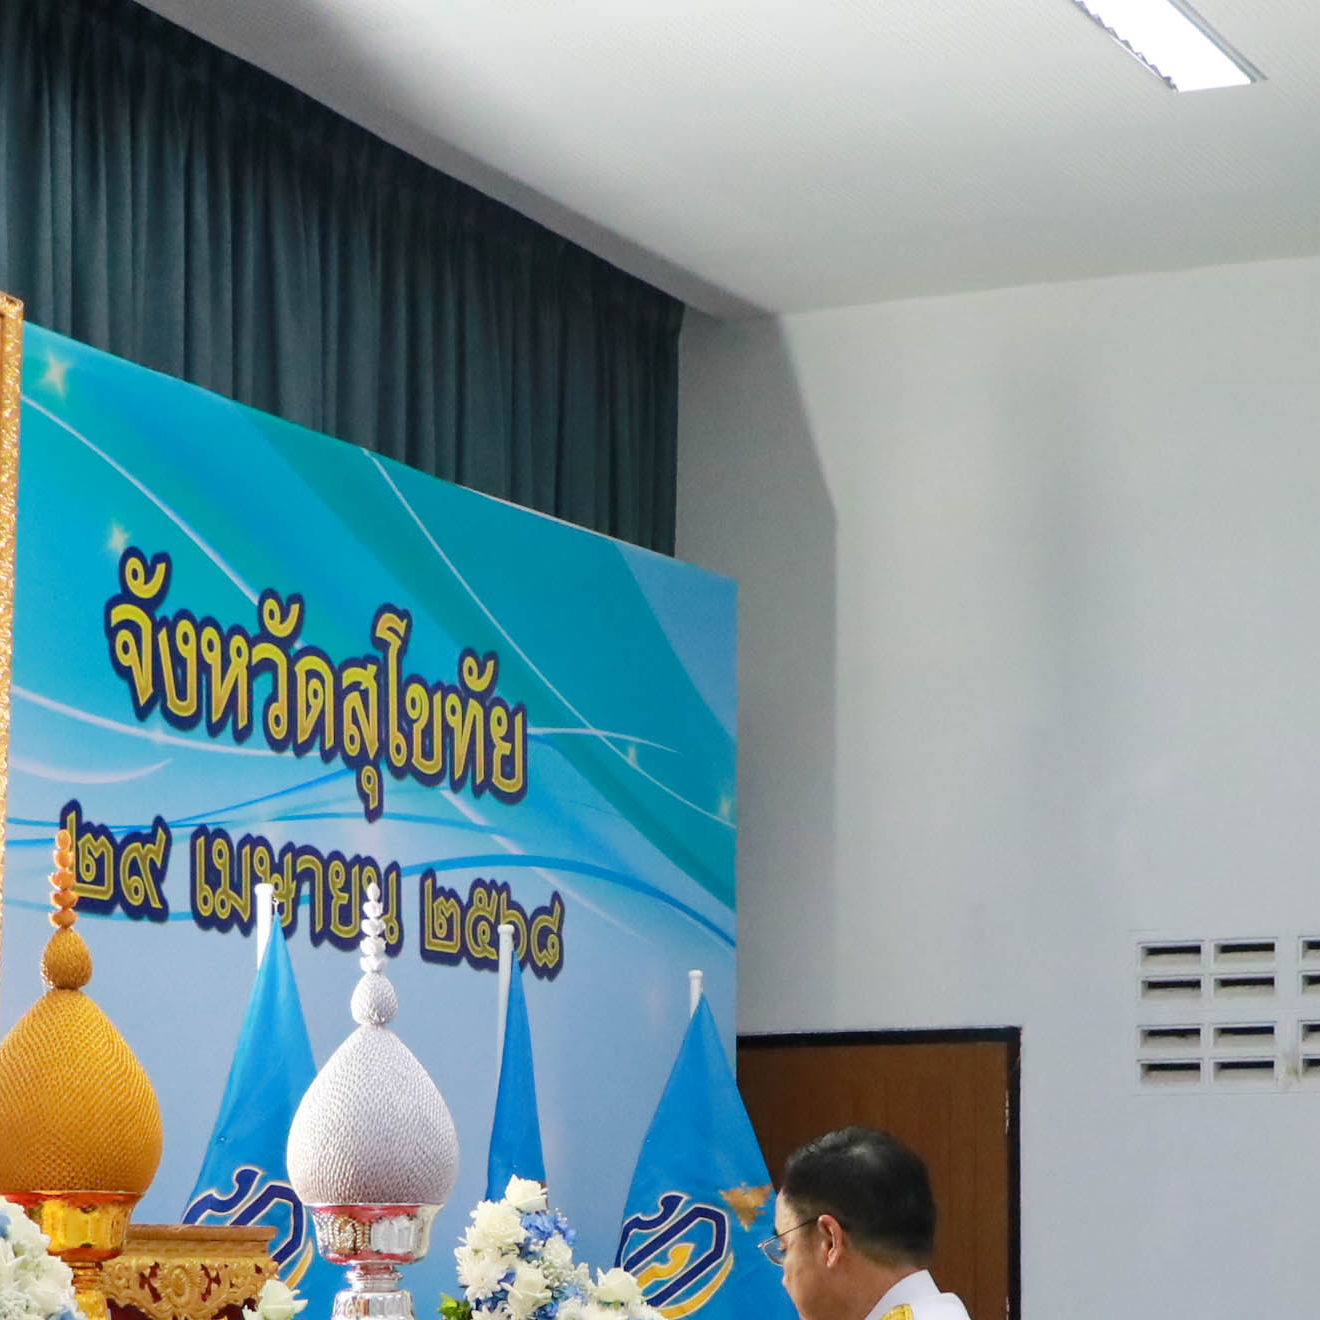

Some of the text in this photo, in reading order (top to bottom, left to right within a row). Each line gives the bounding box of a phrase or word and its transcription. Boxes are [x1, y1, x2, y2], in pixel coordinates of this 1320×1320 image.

[109, 555, 526, 809] จังหวัดสุโขทัย
[66, 809, 167, 909] ๒๙
[424, 877, 561, 969] ๒๕๖๘
